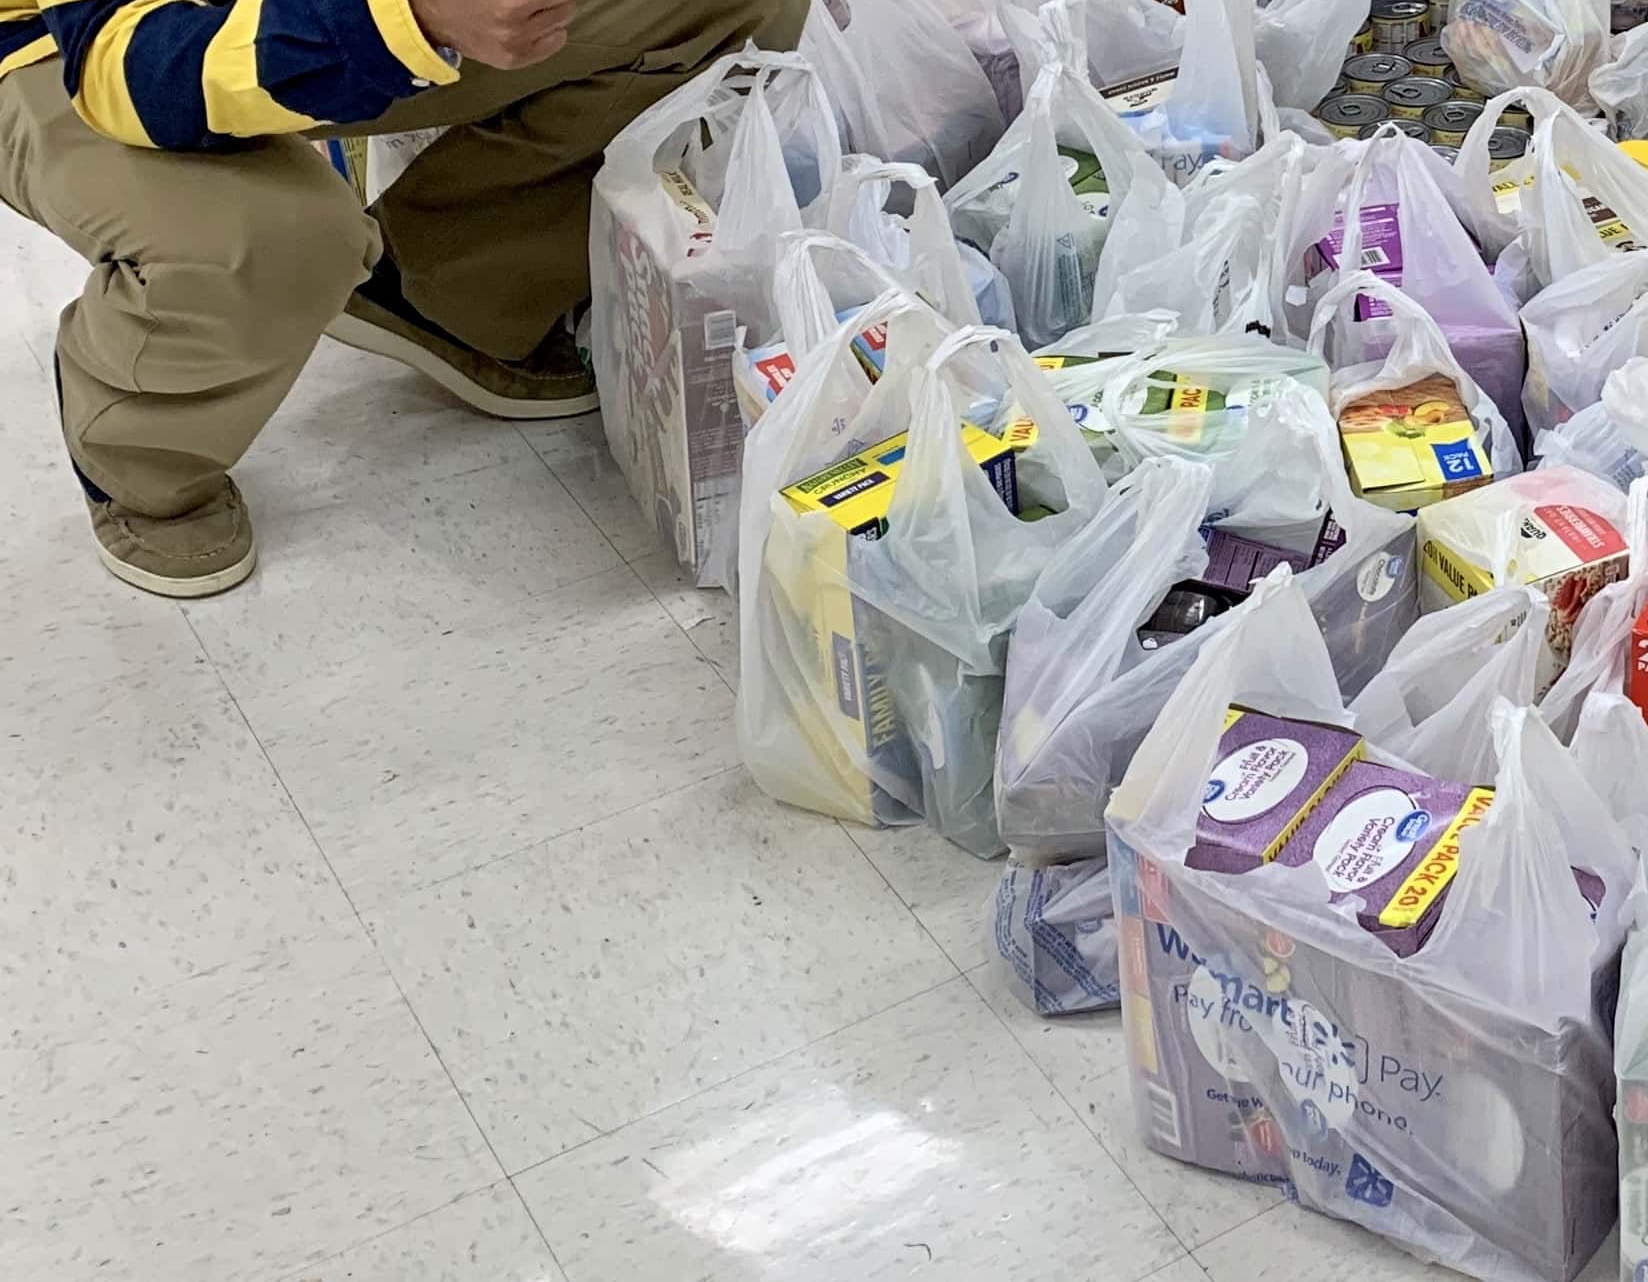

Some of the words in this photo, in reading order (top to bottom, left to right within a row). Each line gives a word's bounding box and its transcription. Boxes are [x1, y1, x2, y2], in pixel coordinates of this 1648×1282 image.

[1181, 387, 1202, 409] PAC
[1010, 418, 1035, 443] VAL
[1442, 451, 1469, 460] PACK
[1446, 457, 1475, 473] 12
[1438, 551, 1466, 594] VALUE
[1265, 749, 1289, 771] Pack
[1334, 853, 1354, 878] Pack
[1414, 844, 1459, 886] PACK
[1397, 885, 1428, 907] 20
[1157, 923, 1292, 1026] Wmart
[1173, 983, 1215, 1018] Pay
[1220, 997, 1253, 1031] fro
[1379, 1055, 1444, 1101] Pay.
[1206, 1088, 1229, 1104] Get
[1303, 1152, 1342, 1176] today.
